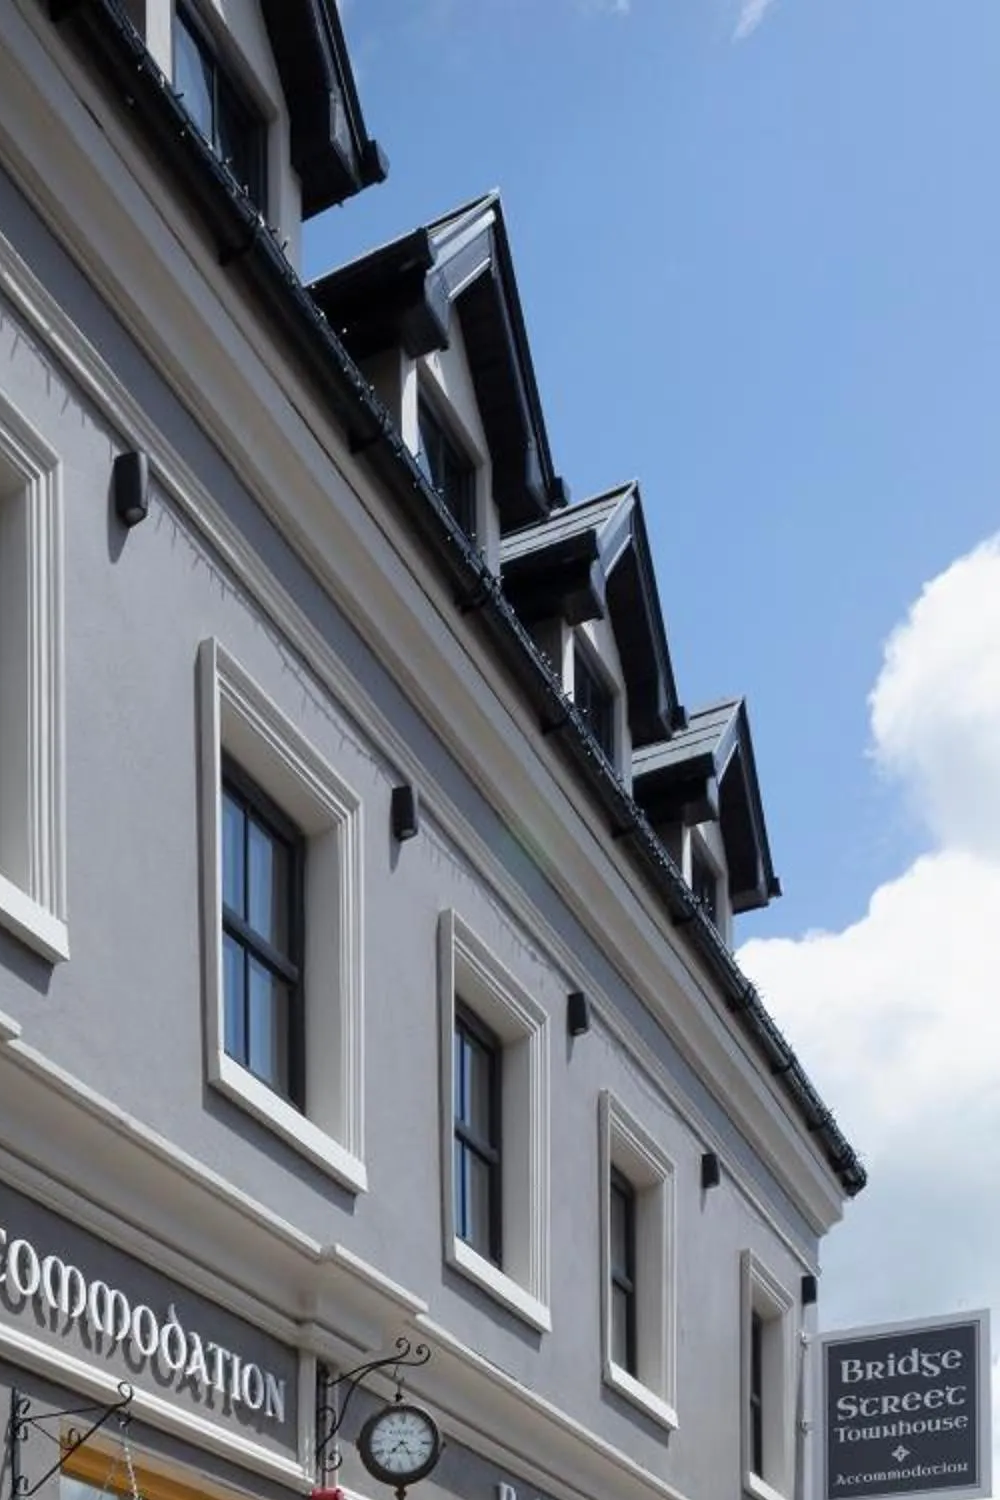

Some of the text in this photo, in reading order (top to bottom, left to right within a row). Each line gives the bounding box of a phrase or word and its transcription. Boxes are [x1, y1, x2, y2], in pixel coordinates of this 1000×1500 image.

[840, 1348, 963, 1384] Bridge
[836, 1385, 967, 1421] Street
[833, 1415, 969, 1444] Townhouse
[834, 1462, 969, 1486] Accommodation
